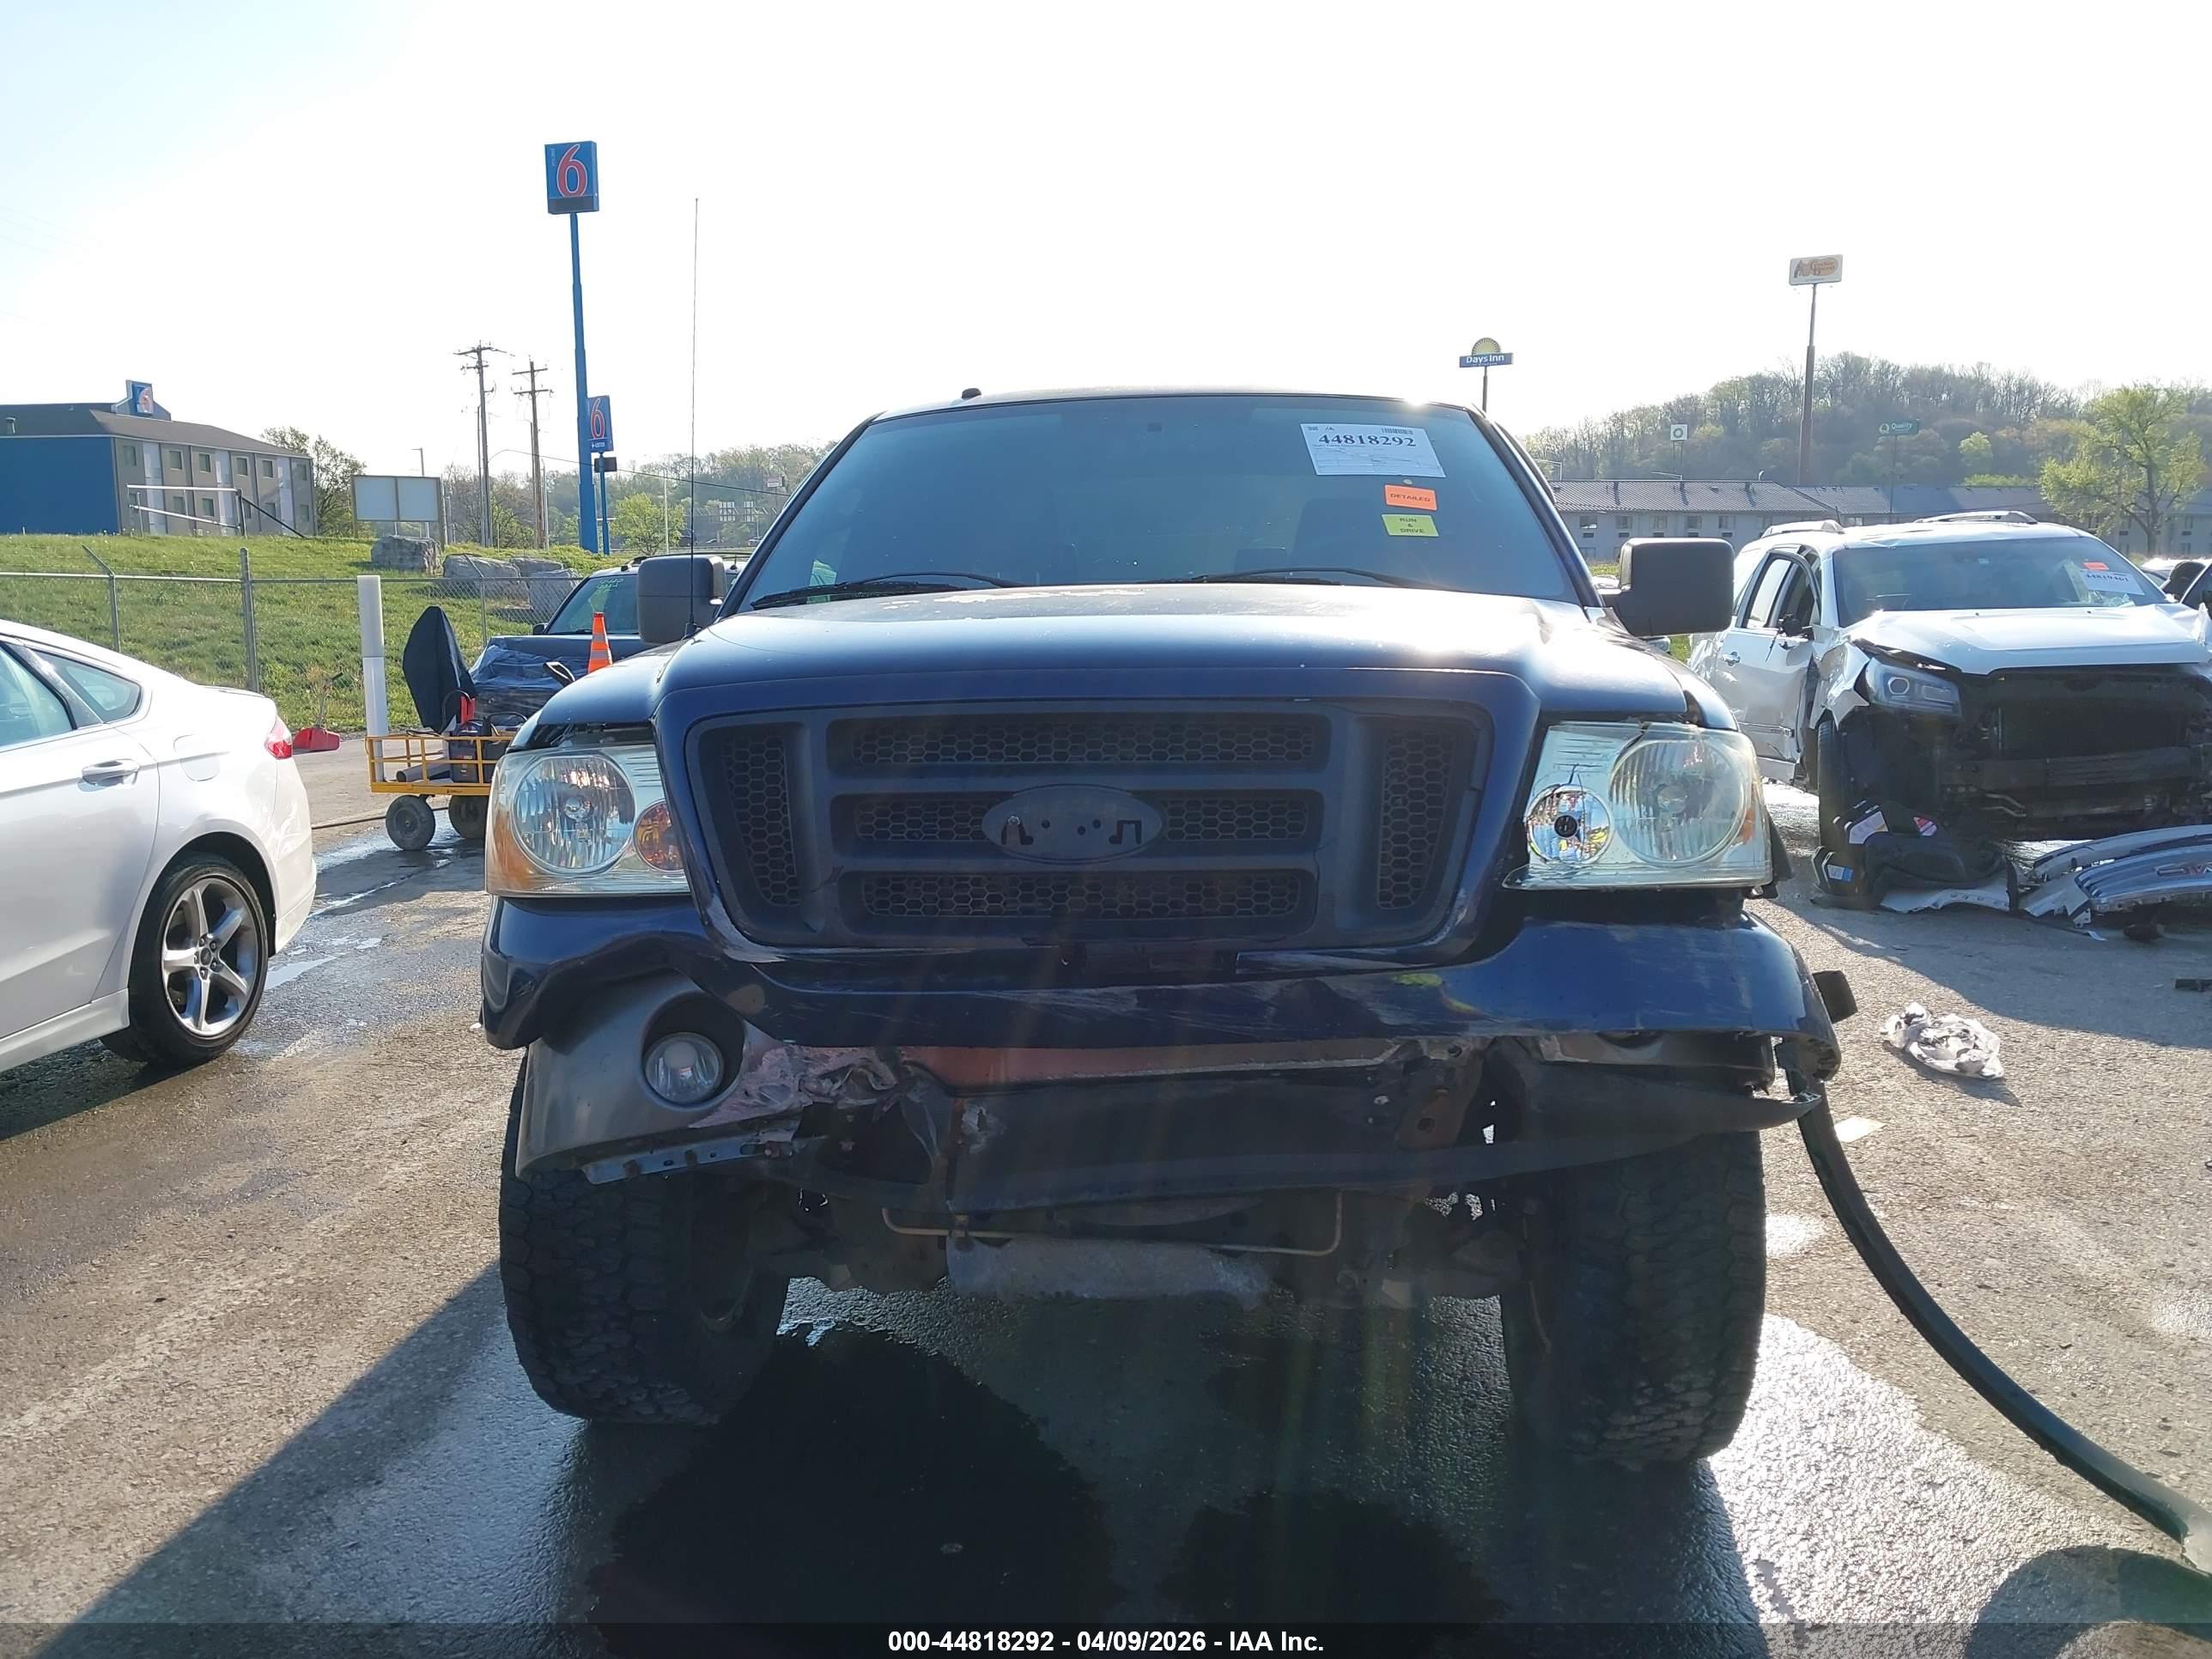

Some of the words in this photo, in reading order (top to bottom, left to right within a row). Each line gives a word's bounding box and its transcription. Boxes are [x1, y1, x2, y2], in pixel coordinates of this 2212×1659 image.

[556, 143, 588, 197] 6
[1466, 356, 1489, 364] Days
[1489, 354, 1504, 362] Inn
[591, 398, 605, 439] 6
[1318, 434, 1416, 447] 44818292
[1390, 493, 1431, 502] DETAILED
